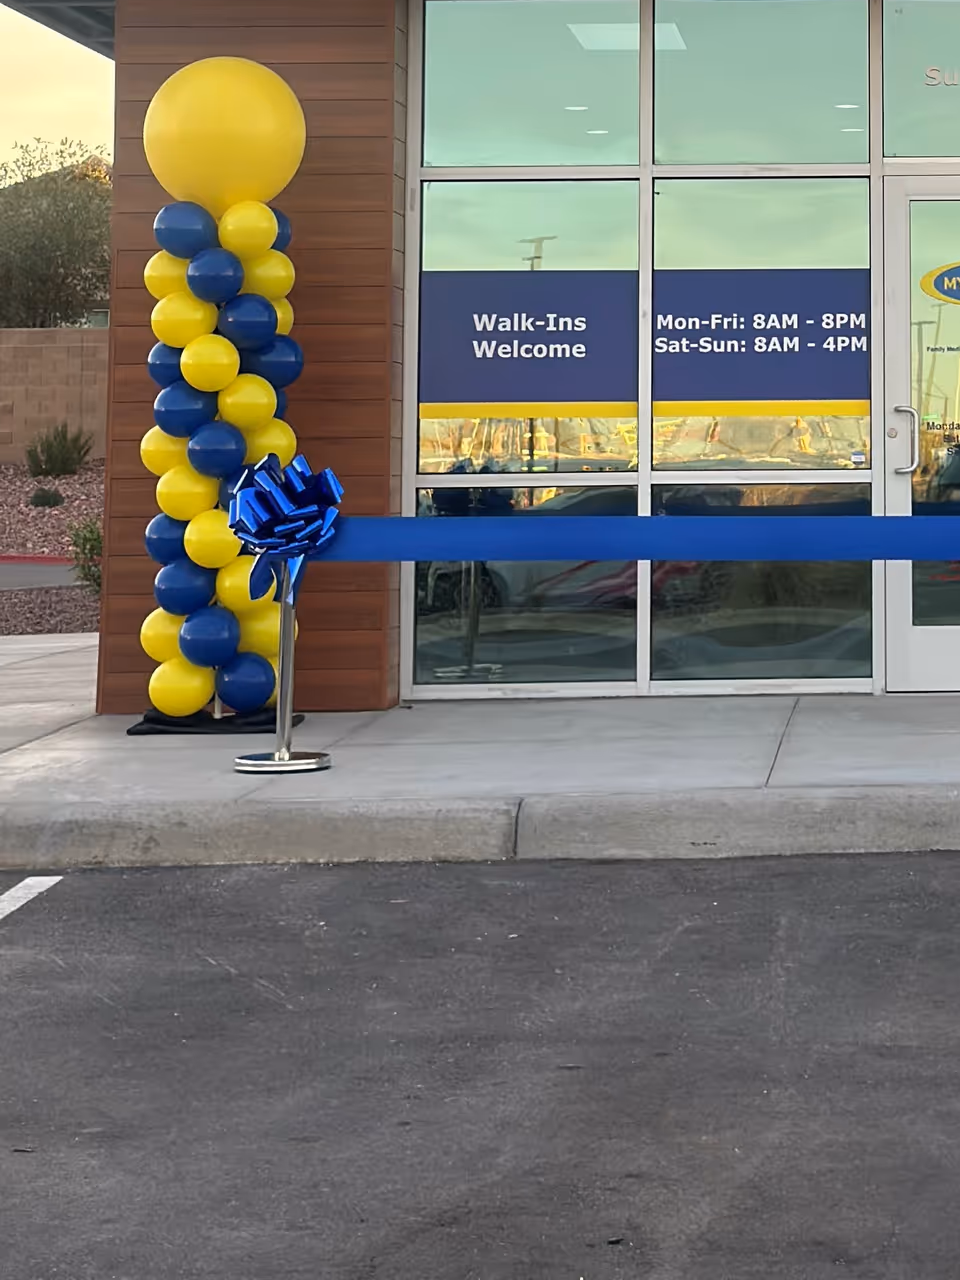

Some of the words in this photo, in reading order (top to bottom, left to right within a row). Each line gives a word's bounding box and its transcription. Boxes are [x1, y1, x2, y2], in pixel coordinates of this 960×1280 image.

[473, 313, 587, 332] Walk-Ins
[656, 313, 746, 331] Mon-Fri:
[752, 313, 799, 330] 8AM
[821, 313, 867, 330] 8PM
[472, 339, 587, 359] Welcome
[654, 336, 747, 354] Sat-Sun:
[753, 336, 800, 353] 8AM
[822, 336, 868, 352] 4PM
